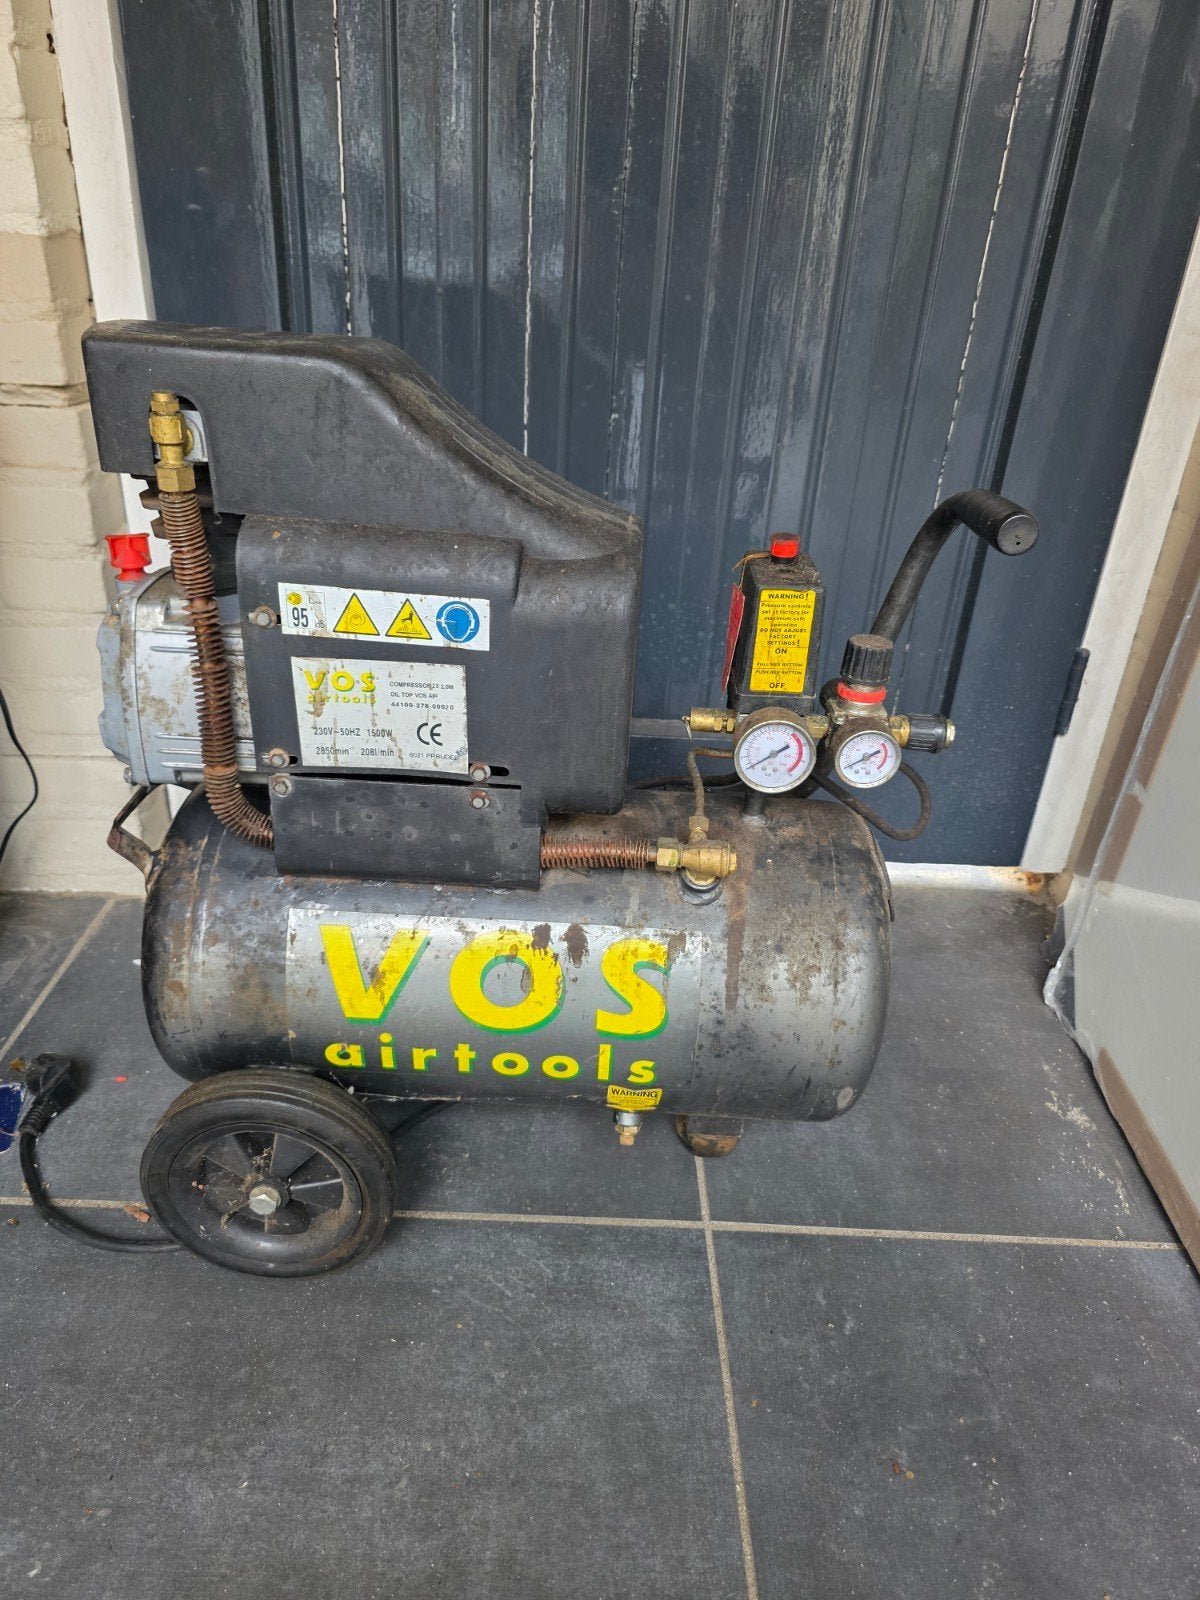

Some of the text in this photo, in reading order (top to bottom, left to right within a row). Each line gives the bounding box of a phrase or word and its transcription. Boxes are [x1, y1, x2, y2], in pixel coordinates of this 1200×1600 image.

[291, 606, 308, 628] 95
[304, 669, 376, 692] VOS
[389, 681, 430, 689] COMPRESSOR
[367, 729, 393, 738] 1500W
[416, 722, 443, 747] CE
[319, 923, 671, 1041] VOS
[324, 1033, 658, 1085] airtools
[611, 1088, 658, 1098] WARNING
